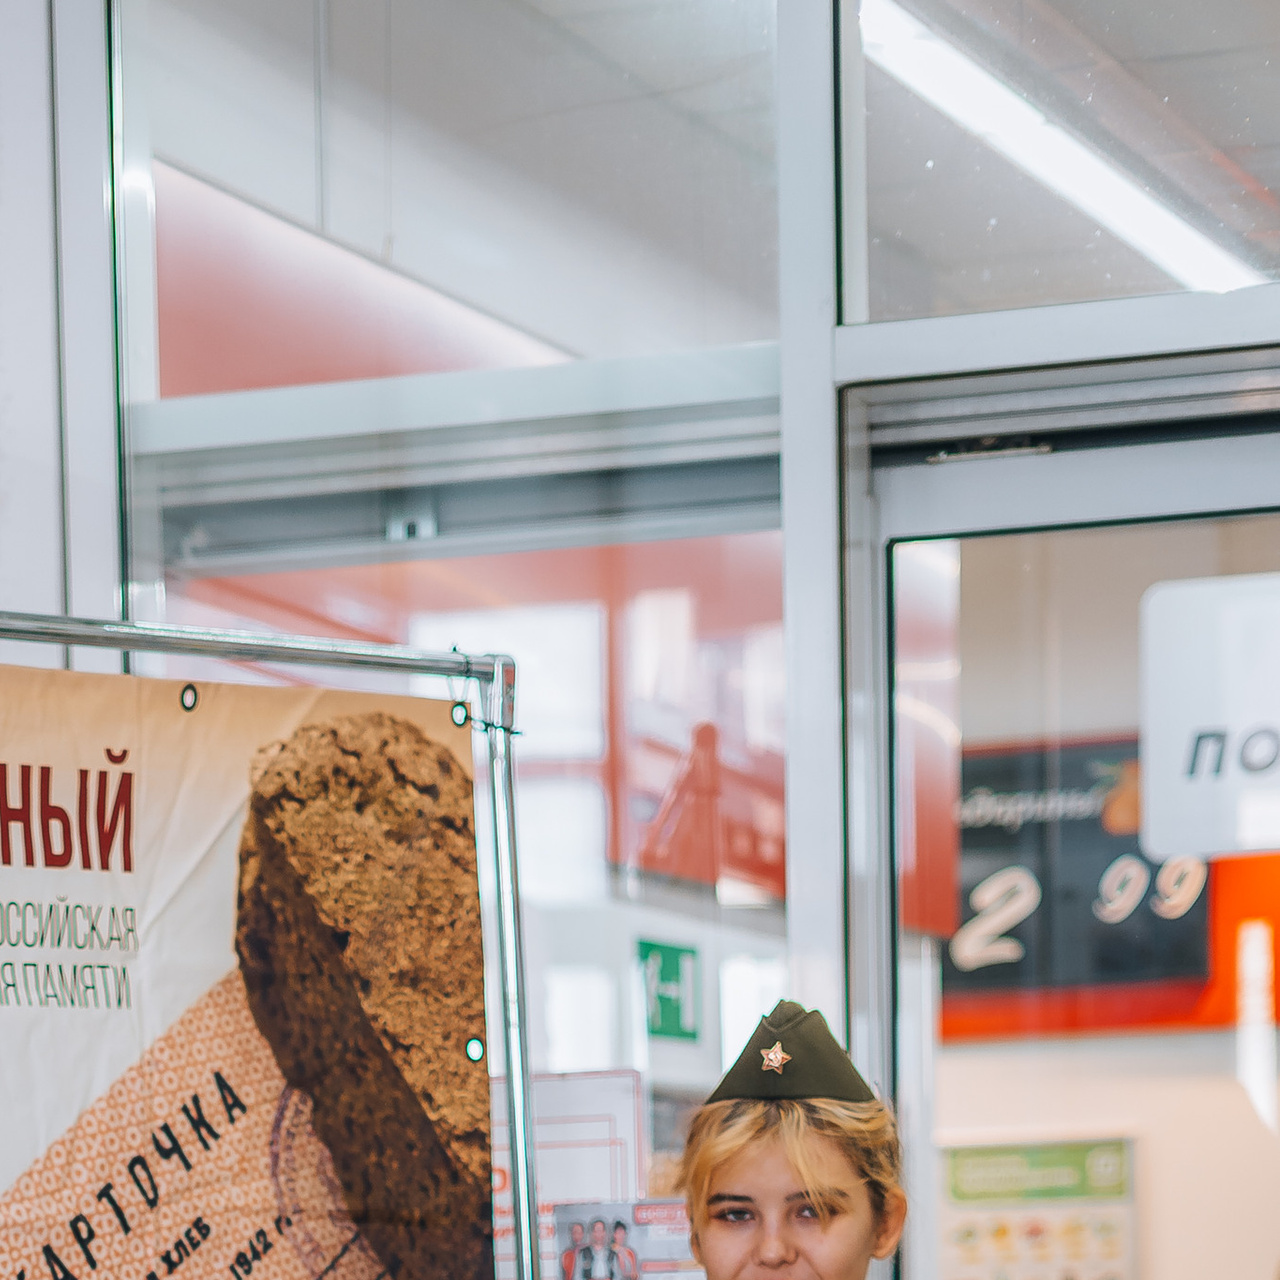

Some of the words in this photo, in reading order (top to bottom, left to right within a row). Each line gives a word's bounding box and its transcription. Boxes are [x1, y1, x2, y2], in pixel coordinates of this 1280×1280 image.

[949, 865, 1041, 973] 2
[23, 962, 132, 1010] ПАМЯТИ
[161, 1216, 211, 1275] ХЛЕБ
